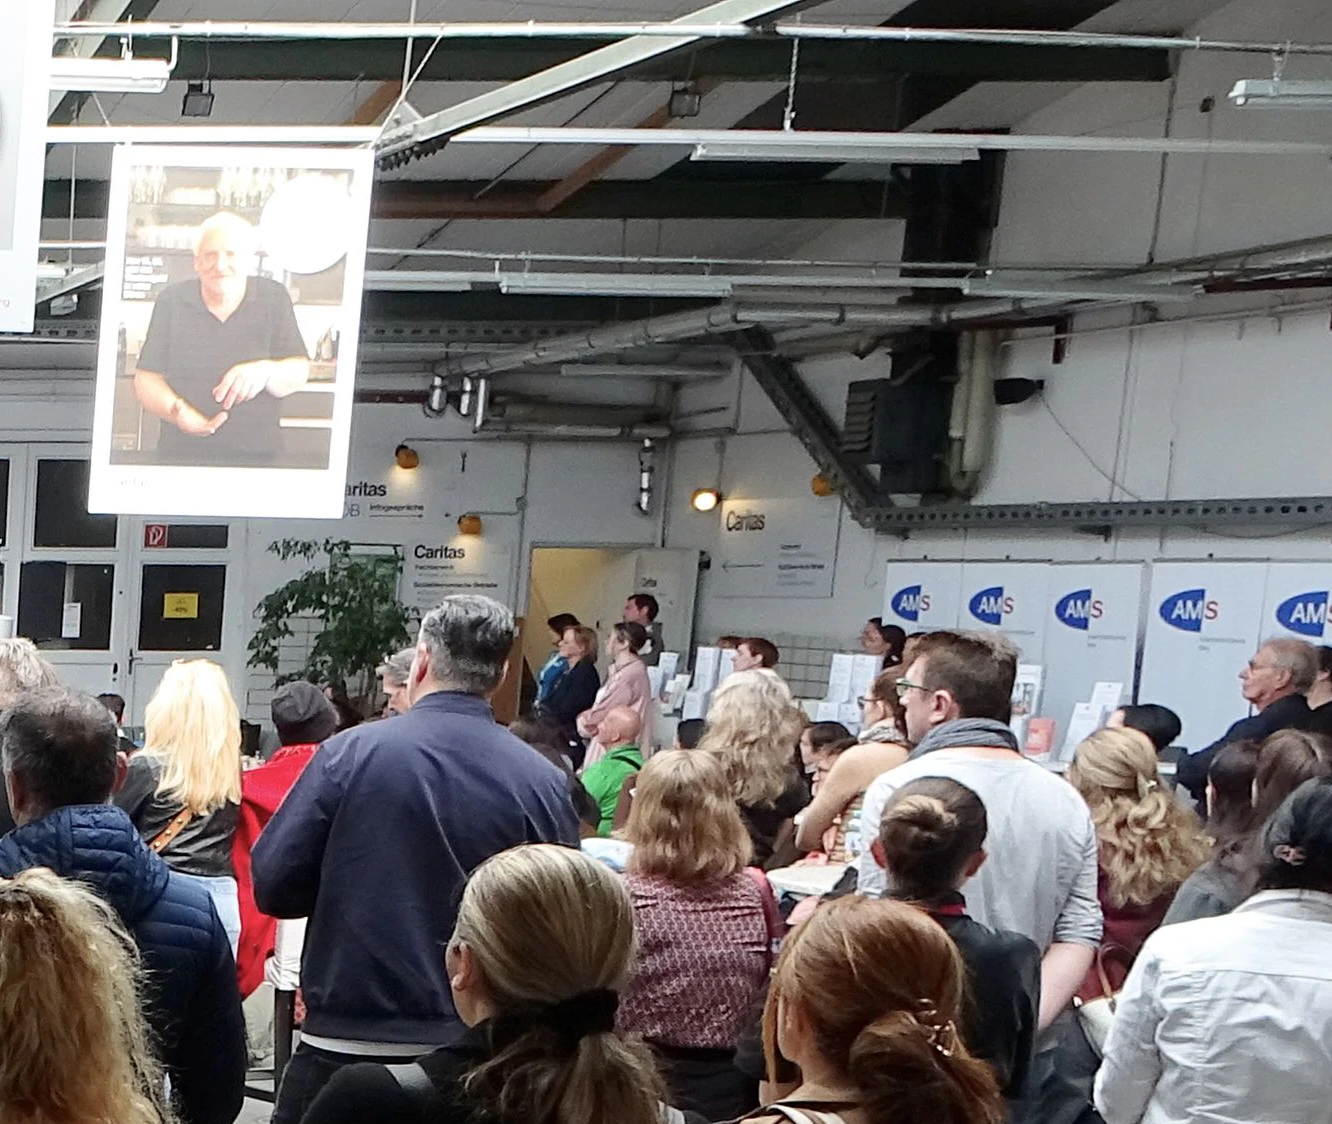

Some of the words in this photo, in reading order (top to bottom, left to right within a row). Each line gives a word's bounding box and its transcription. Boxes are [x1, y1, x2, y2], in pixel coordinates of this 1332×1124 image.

[346, 481, 387, 497] aritas
[726, 511, 766, 532] Caritas
[414, 544, 466, 560] Caritas
[898, 594, 931, 612] AMS
[978, 596, 1015, 614] AMS
[1065, 600, 1103, 619] AMS
[1171, 600, 1219, 620] AMS
